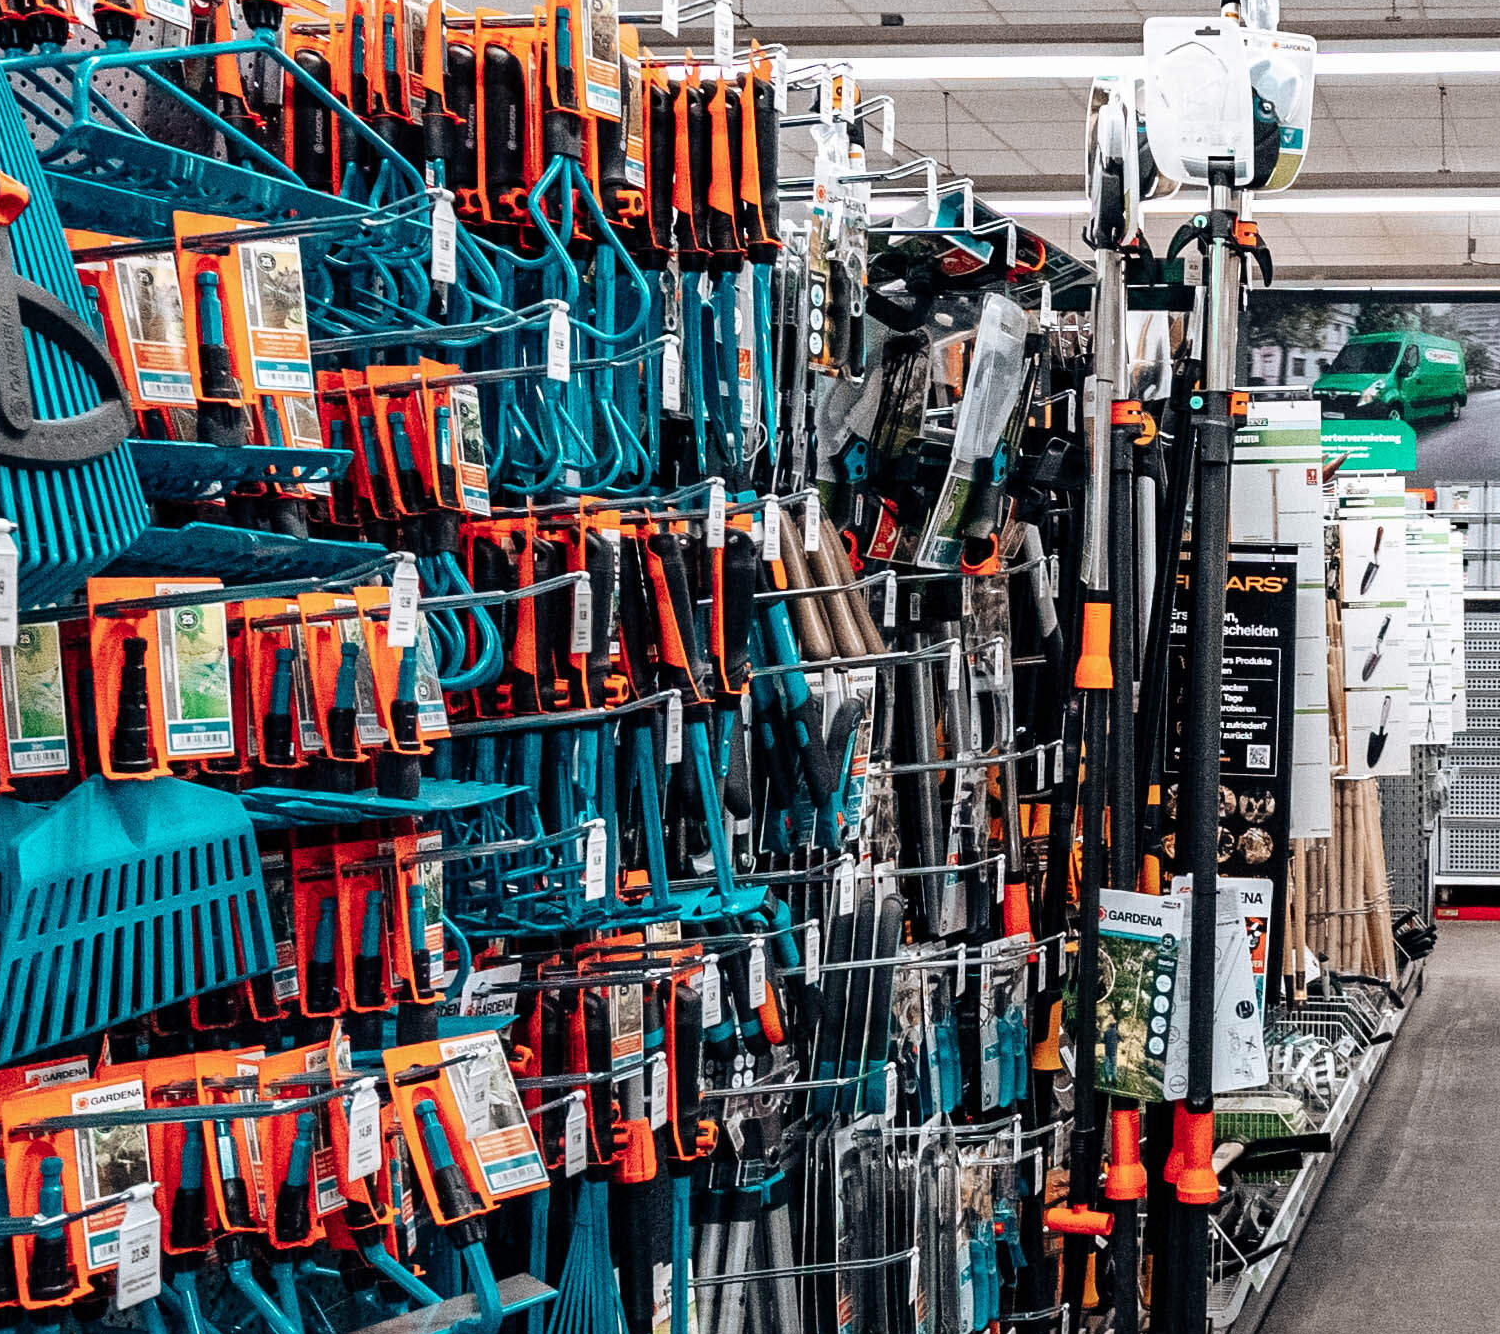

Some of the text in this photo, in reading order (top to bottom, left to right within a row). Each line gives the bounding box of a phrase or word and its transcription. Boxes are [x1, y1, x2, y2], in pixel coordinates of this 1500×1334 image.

[1176, 574, 1283, 593] FIARS
[1108, 910, 1163, 927] GARDENA
[42, 1067, 88, 1084] GARDENA
[91, 1088, 142, 1107] GARDENA
